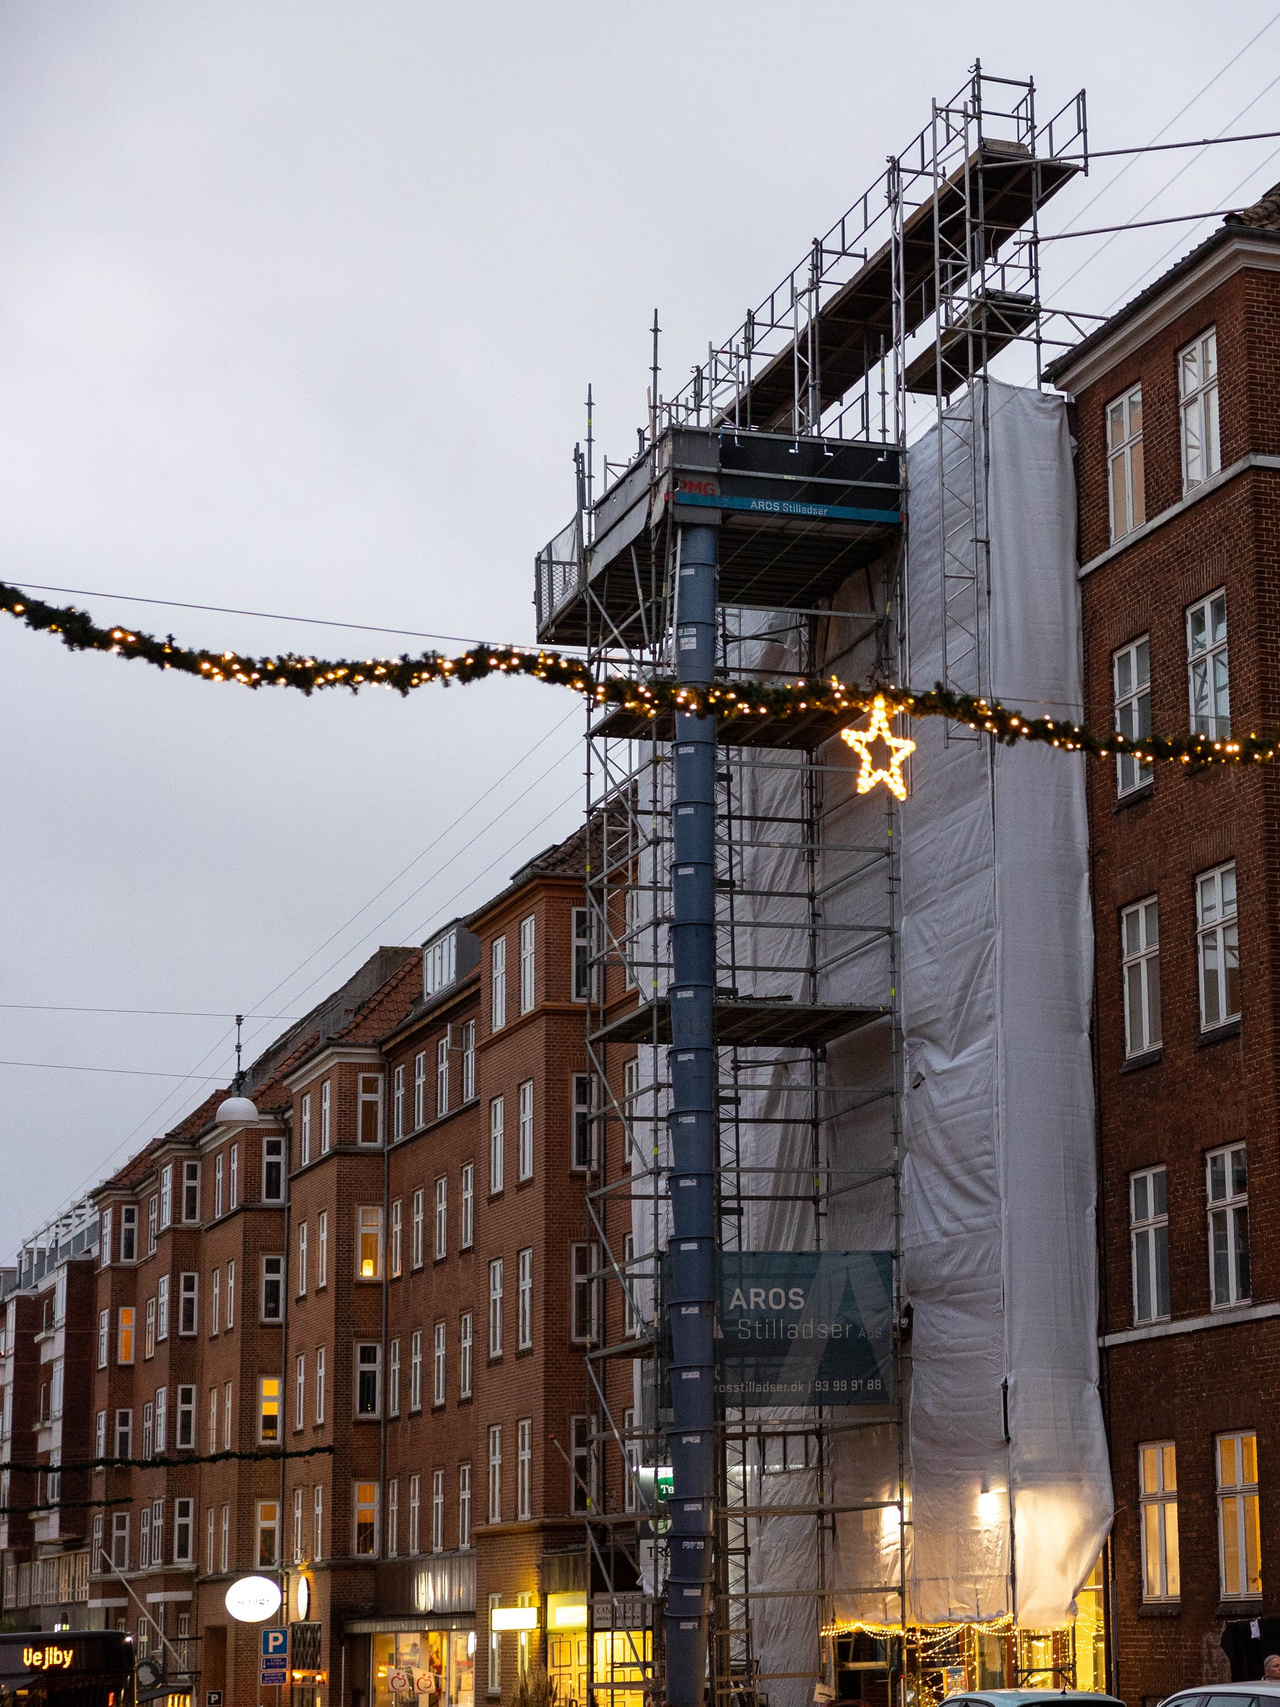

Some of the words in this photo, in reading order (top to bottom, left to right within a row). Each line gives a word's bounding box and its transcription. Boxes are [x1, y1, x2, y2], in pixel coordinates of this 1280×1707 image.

[750, 500, 780, 512] AROS
[782, 502, 828, 516] Stilladser
[729, 1287, 805, 1310] AROS
[738, 1318, 853, 1340] Stilladser
[858, 1326, 882, 1341] ApS
[815, 1380, 829, 1392] 93
[833, 1380, 847, 1391] 99
[867, 1379, 882, 1391] 88
[268, 1632, 284, 1653] P
[23, 1646, 73, 1670] Vejlby
